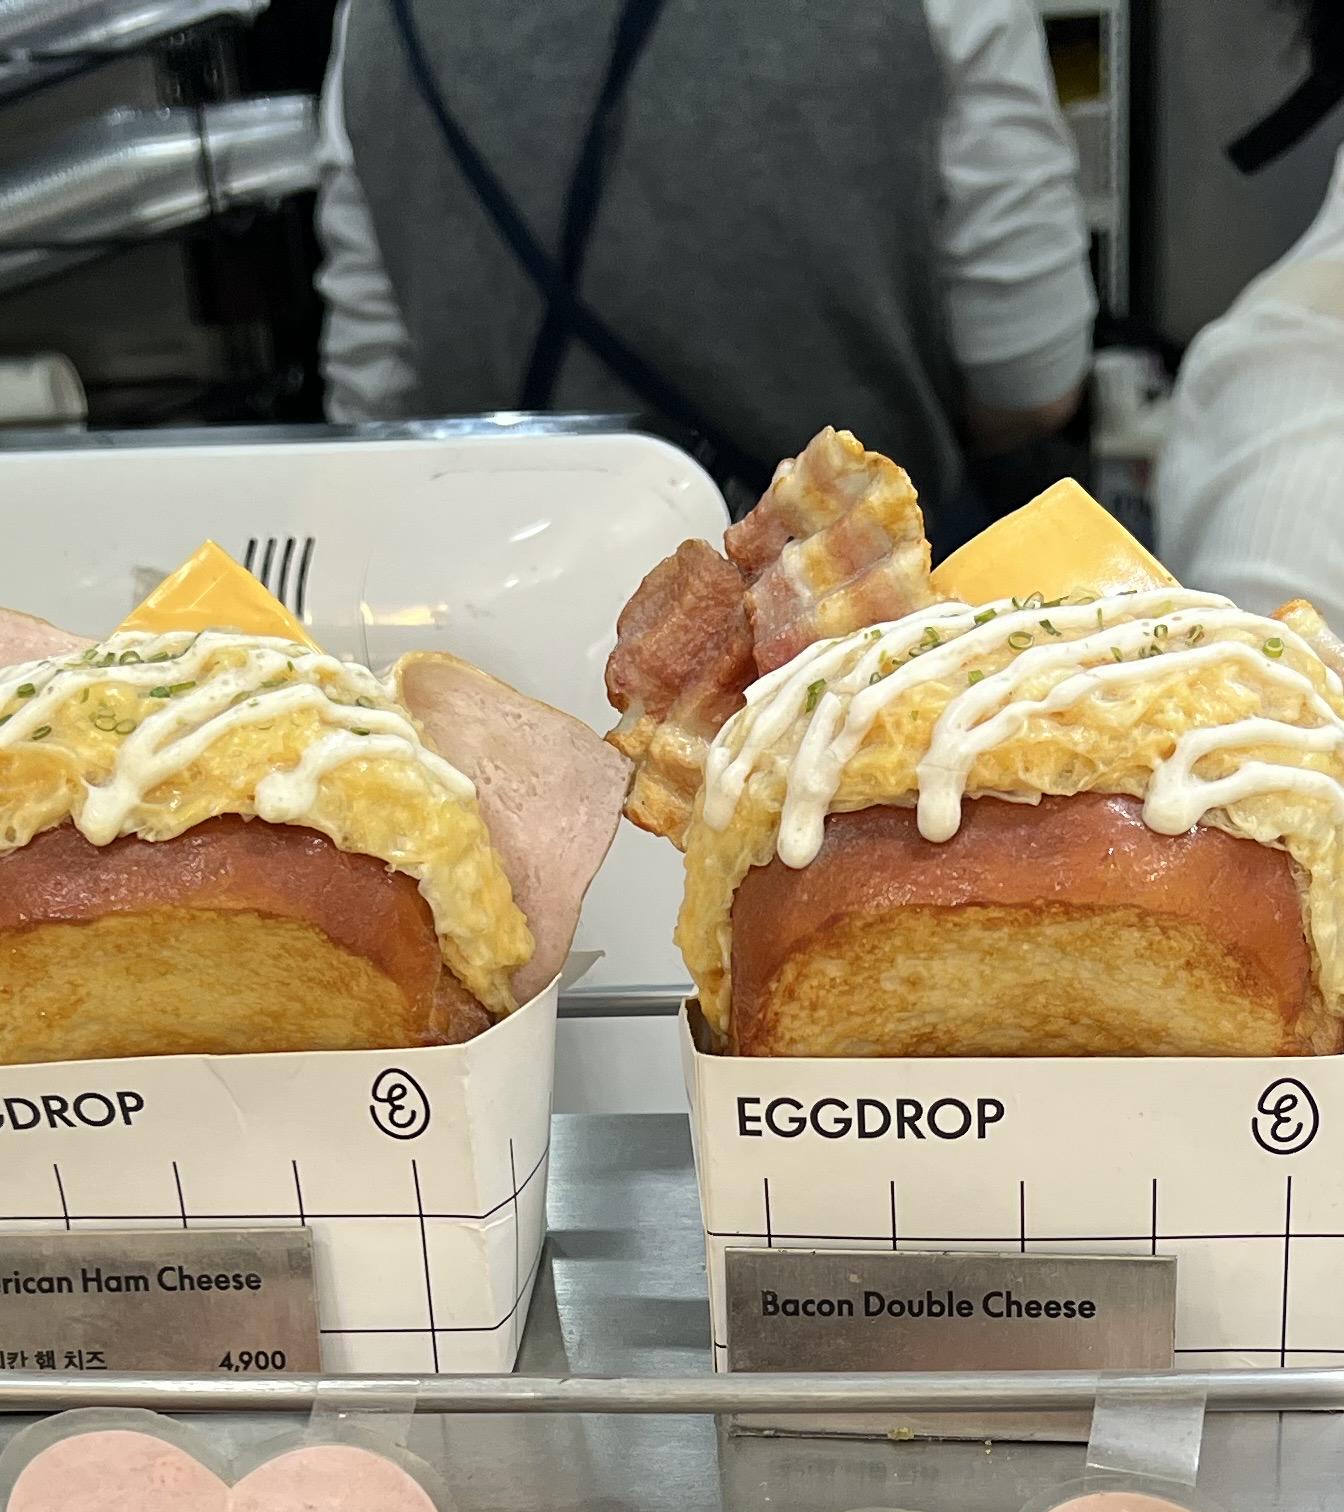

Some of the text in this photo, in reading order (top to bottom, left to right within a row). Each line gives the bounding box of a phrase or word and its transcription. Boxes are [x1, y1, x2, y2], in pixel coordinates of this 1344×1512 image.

[737, 1096, 1006, 1140] EGGDROP
[81, 1268, 150, 1294] Ham
[157, 1266, 262, 1292] Cheese
[760, 1290, 1097, 1320] Bacon Double Cheese
[64, 1350, 107, 1371] 치즈
[219, 1350, 287, 1372] 4,900
